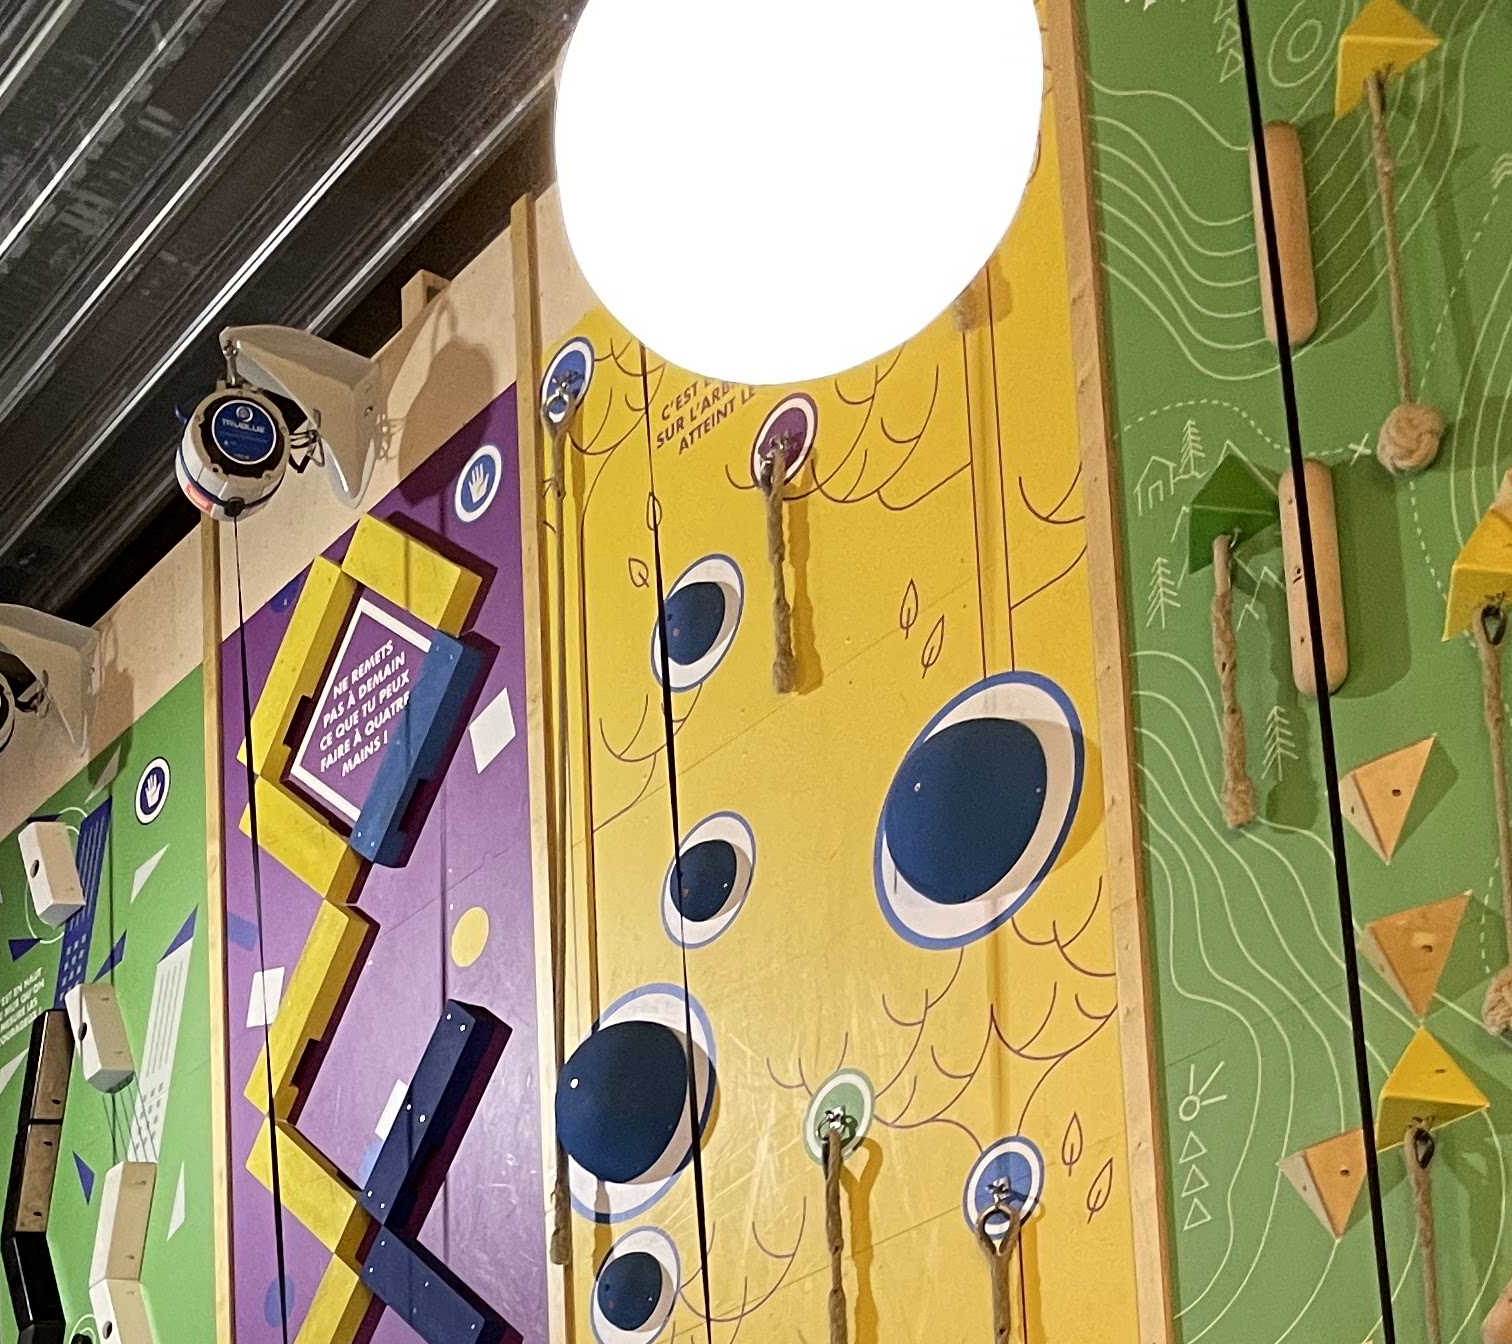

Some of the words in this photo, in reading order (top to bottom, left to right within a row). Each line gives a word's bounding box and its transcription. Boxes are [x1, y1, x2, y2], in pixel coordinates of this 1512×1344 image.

[657, 416, 684, 449] SUR
[690, 381, 735, 422] L'ARB
[662, 380, 698, 421] C'EST
[679, 396, 736, 455] ATTEINT
[323, 701, 345, 728] PAS
[347, 689, 356, 709] À
[358, 651, 405, 699] DEMAIN
[333, 676, 349, 699] NE
[351, 639, 394, 684] REMETS
[319, 731, 333, 751] CE
[335, 710, 359, 738] QUE
[362, 695, 376, 717] TU
[379, 669, 409, 704] PEUX
[320, 738, 350, 773] FAIRE
[353, 727, 362, 747] À
[342, 736, 380, 777] MAINS
